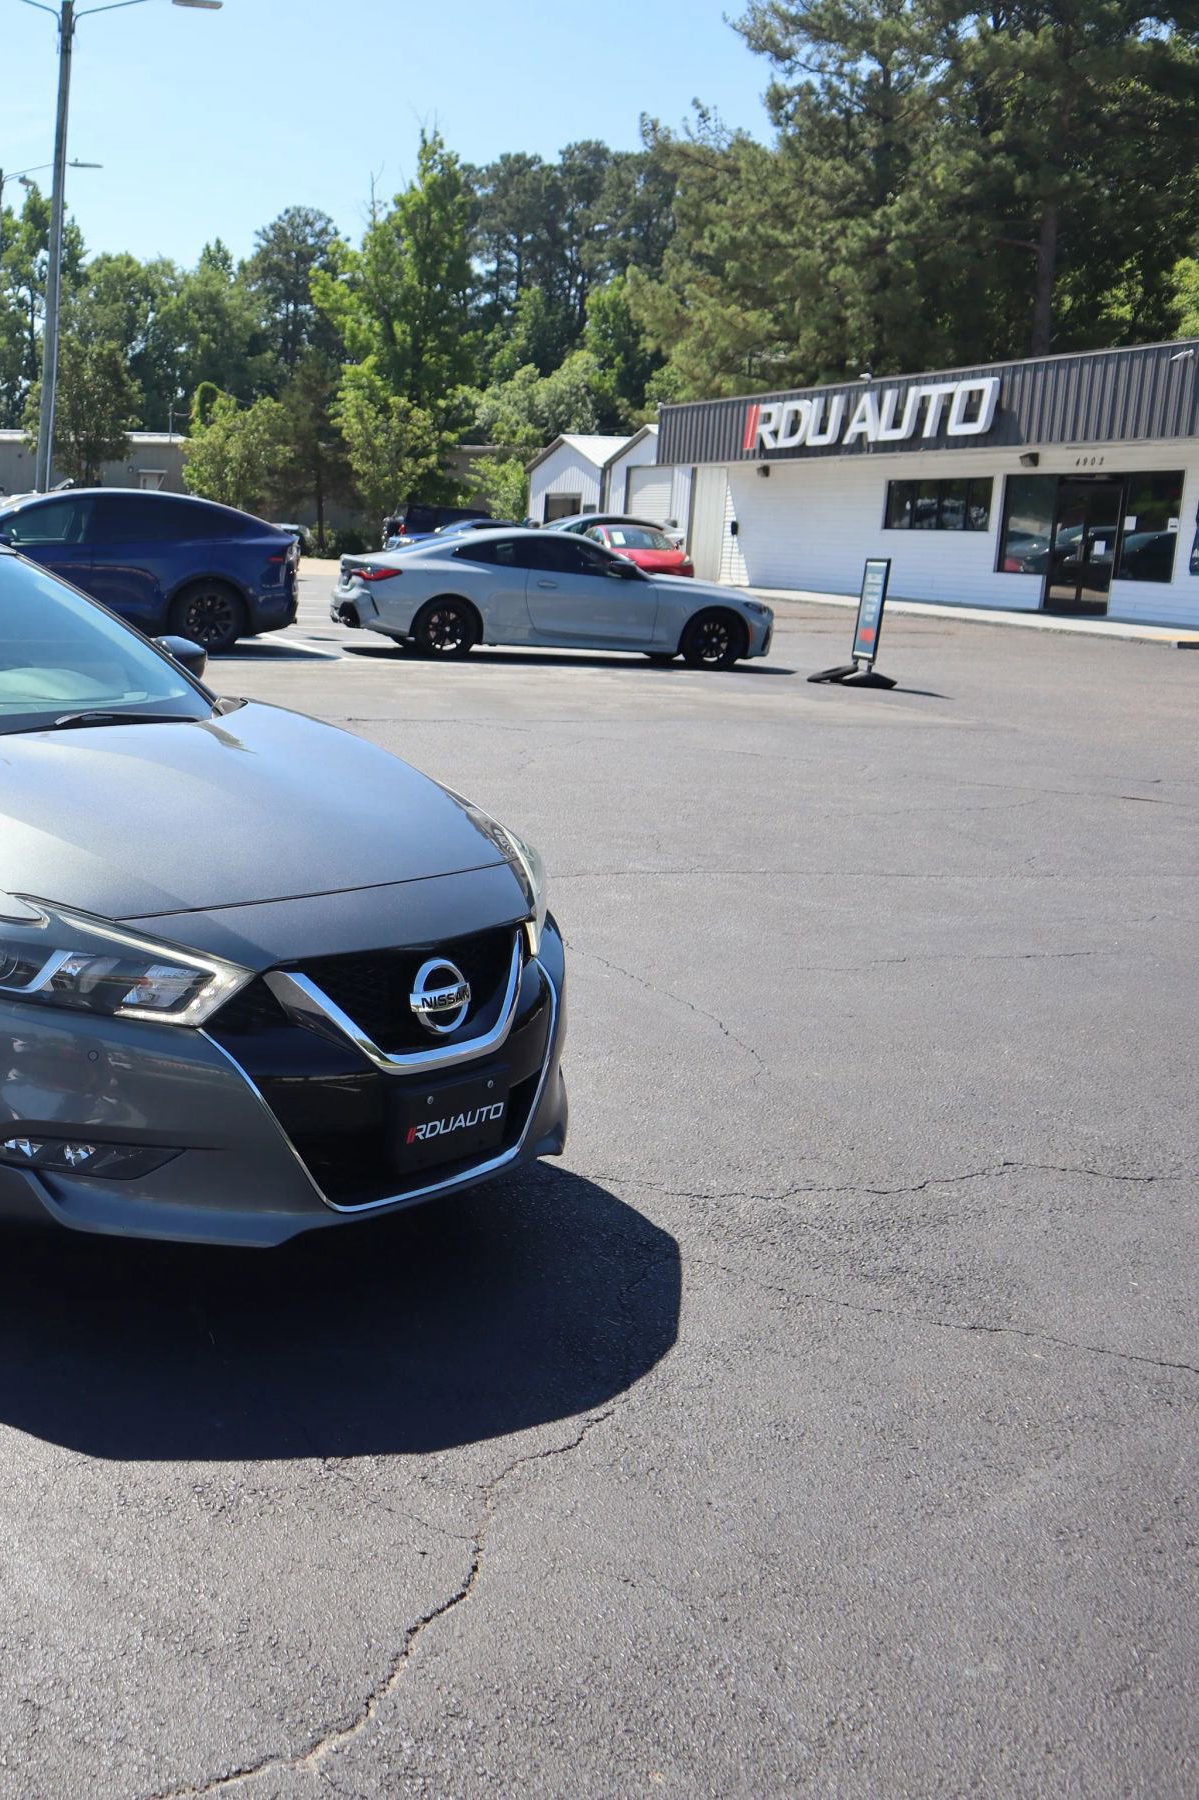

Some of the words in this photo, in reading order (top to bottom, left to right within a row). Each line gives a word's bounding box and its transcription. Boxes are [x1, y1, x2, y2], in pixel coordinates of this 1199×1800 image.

[756, 395, 847, 449] RDU
[842, 377, 1000, 445] AUTO
[421, 988, 470, 1010] NISSAN
